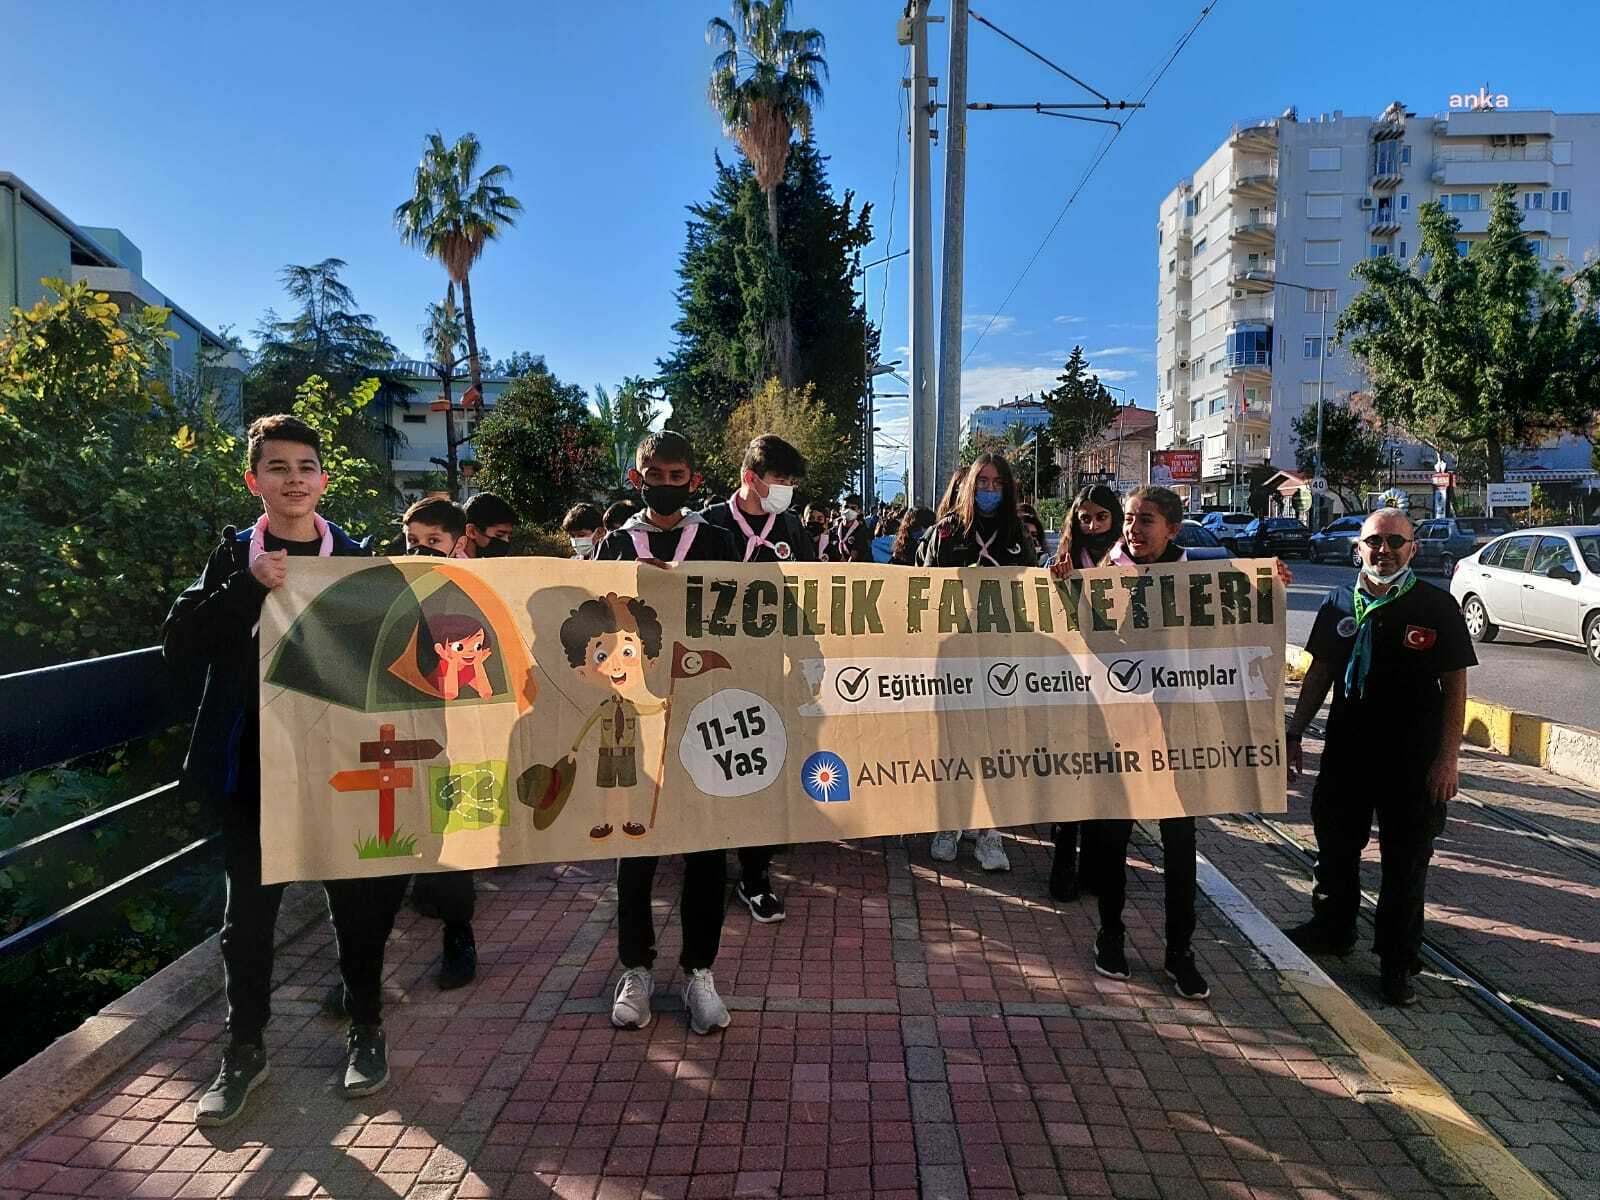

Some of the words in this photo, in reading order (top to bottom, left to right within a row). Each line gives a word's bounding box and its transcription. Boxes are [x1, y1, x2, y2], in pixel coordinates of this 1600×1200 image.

[1449, 88, 1509, 107] anka
[1313, 480, 1324, 489] 40
[686, 576, 884, 638] İZCİLİK
[907, 568, 1274, 633] FAALİYETLERİ
[878, 673, 973, 700] Eğitimler
[1025, 671, 1091, 693] Geziler
[1151, 664, 1237, 690] Kamplar
[696, 706, 766, 750] 11-15
[713, 747, 768, 781] Yaş
[856, 757, 973, 786] ANTALYA
[980, 742, 1143, 780] BÜYÜKŞEHİR
[1151, 739, 1280, 771] BELEDİYESİ
